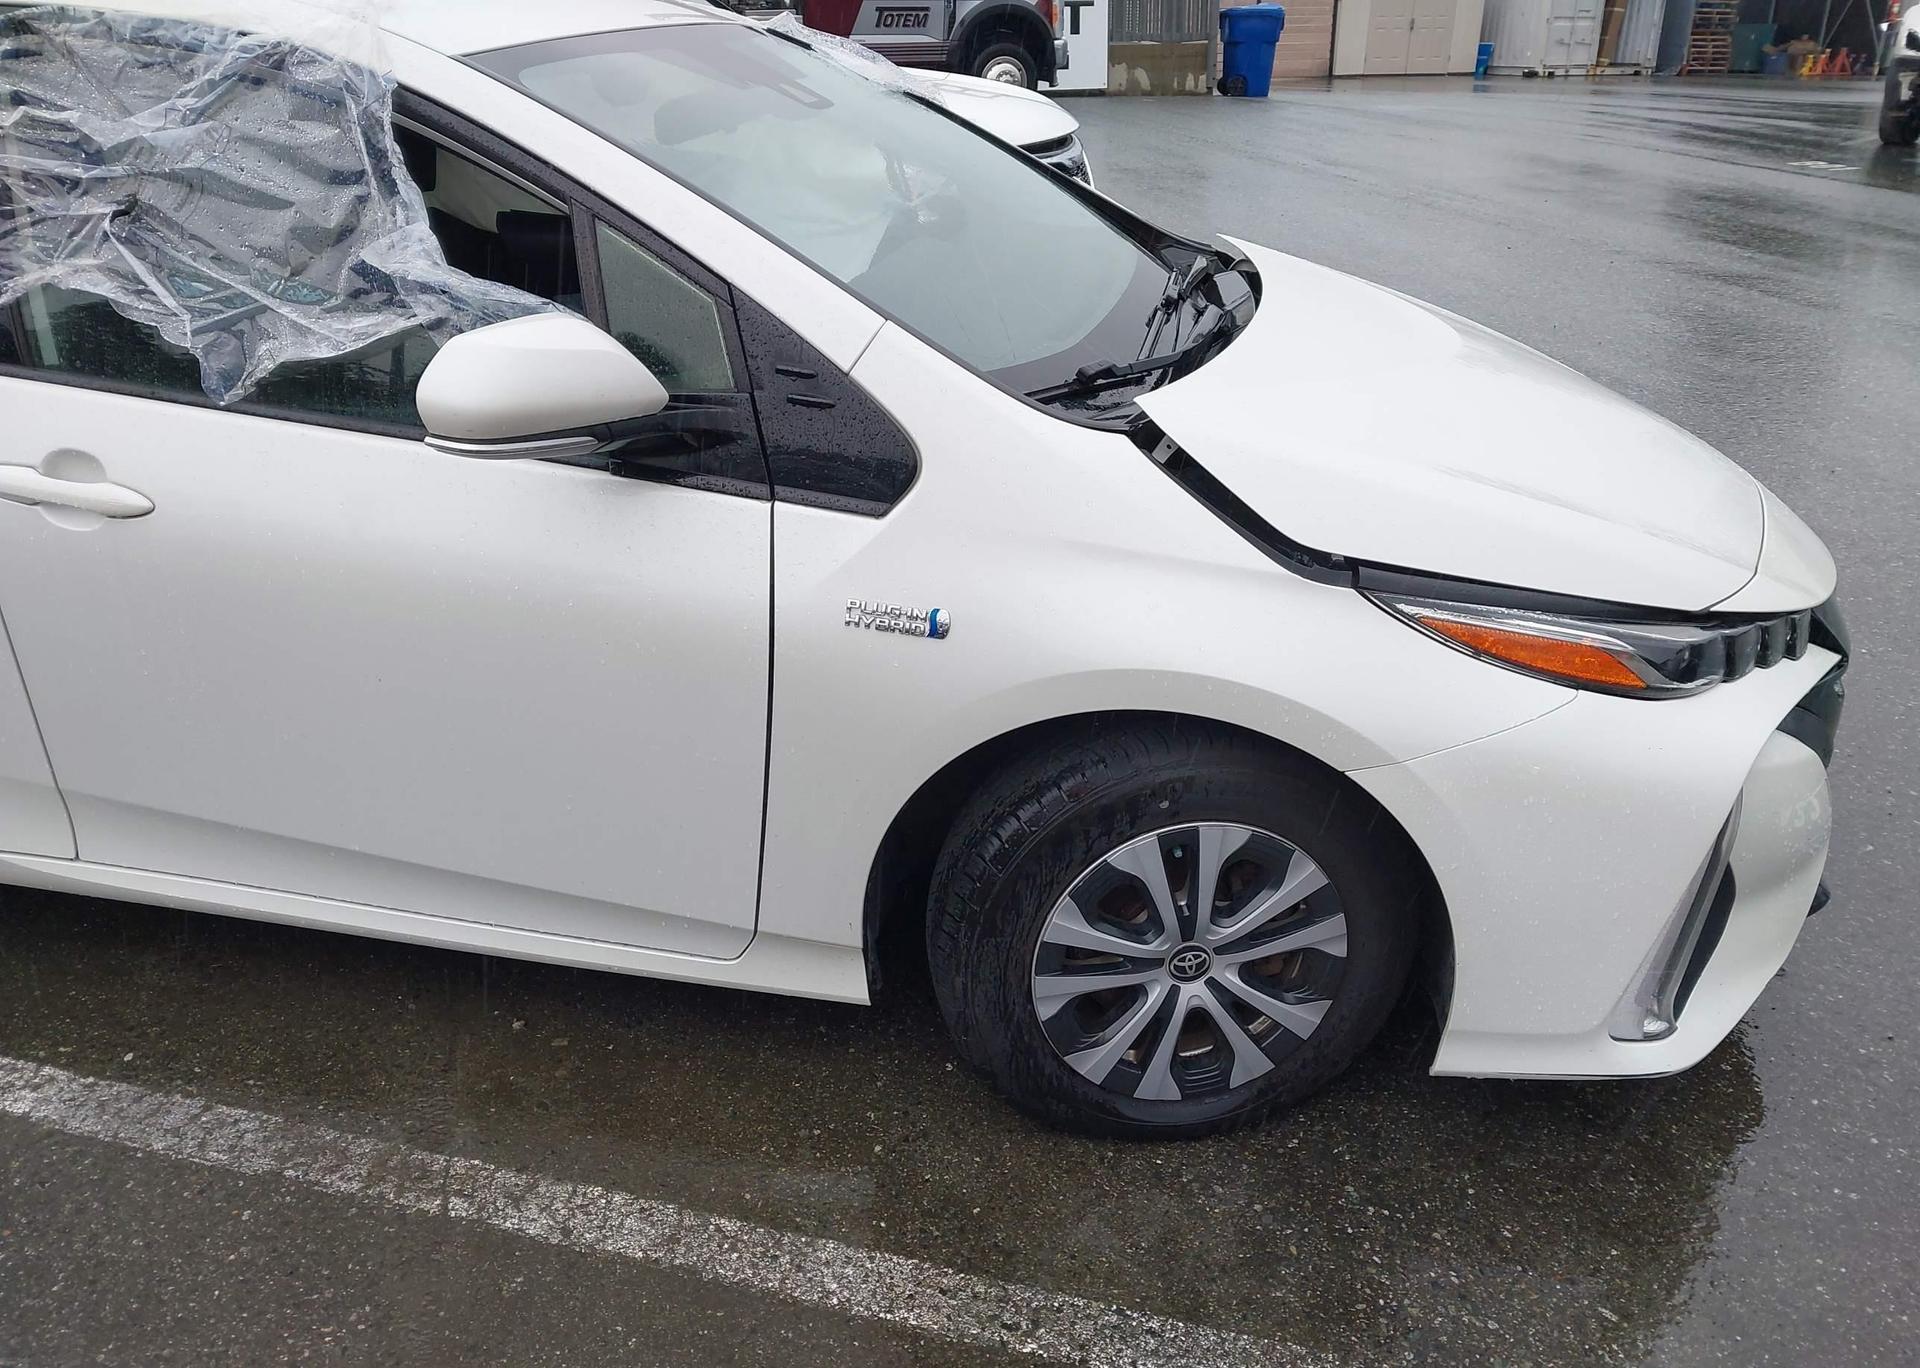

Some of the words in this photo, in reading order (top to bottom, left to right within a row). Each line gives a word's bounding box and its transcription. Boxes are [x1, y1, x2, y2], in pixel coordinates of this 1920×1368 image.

[875, 6, 931, 28] TOTEM
[845, 598, 929, 622] PLUG-IN
[844, 613, 927, 637] HYBRID
